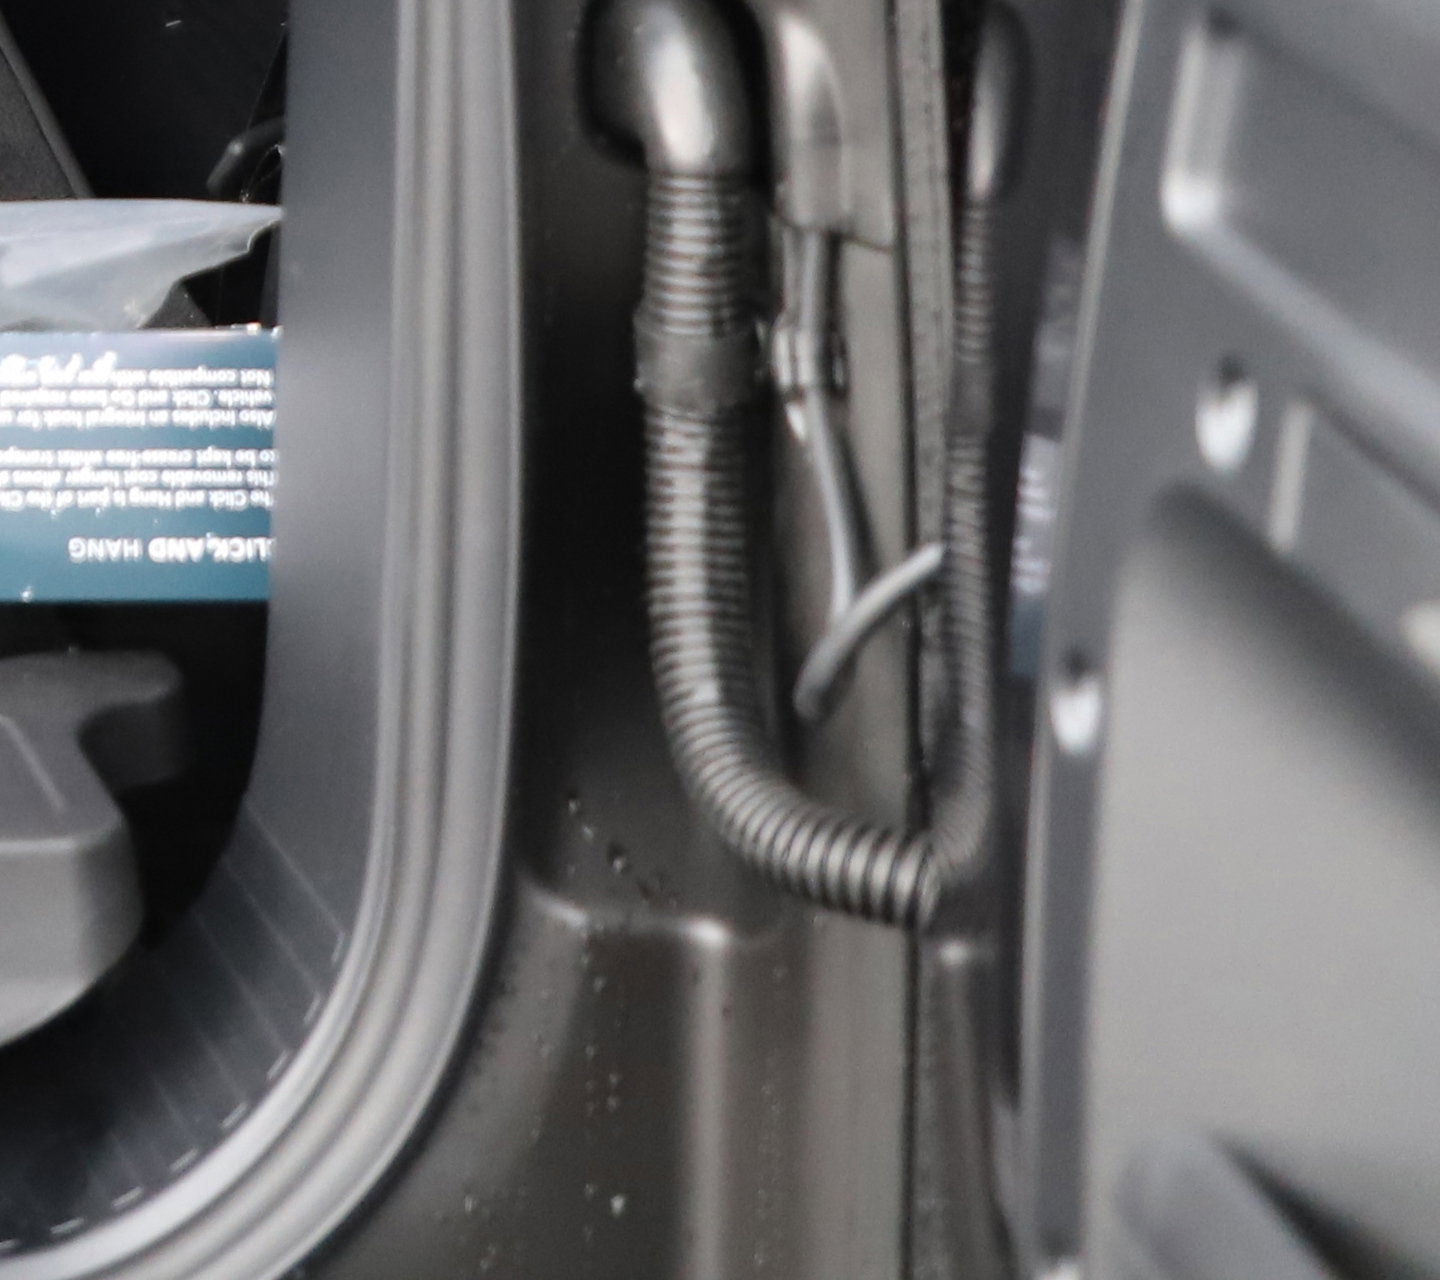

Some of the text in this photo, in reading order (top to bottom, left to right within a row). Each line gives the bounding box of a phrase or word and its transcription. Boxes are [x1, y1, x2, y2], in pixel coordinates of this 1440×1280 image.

[147, 364, 236, 387] compatible
[240, 369, 270, 387] Not
[108, 389, 136, 407] Go
[136, 389, 168, 407] and
[171, 389, 210, 407] Click
[213, 389, 272, 407] vehicle.
[15, 410, 42, 427] for
[83, 405, 146, 427] integral
[147, 410, 169, 423] an
[171, 410, 236, 427] includes
[238, 410, 273, 427] Also
[104, 450, 192, 466] crease-free
[195, 445, 231, 466] kept
[234, 450, 256, 466] be
[11, 470, 62, 487] allows
[64, 465, 120, 487] hanger
[122, 470, 158, 487] coat
[160, 470, 242, 487] removable
[25, 490, 54, 507] the
[55, 490, 74, 507] of
[76, 485, 111, 507] part
[128, 485, 172, 507] Hang
[174, 490, 205, 507] and
[209, 490, 247, 507] Click
[67, 538, 271, 558] LICK AND HANG
